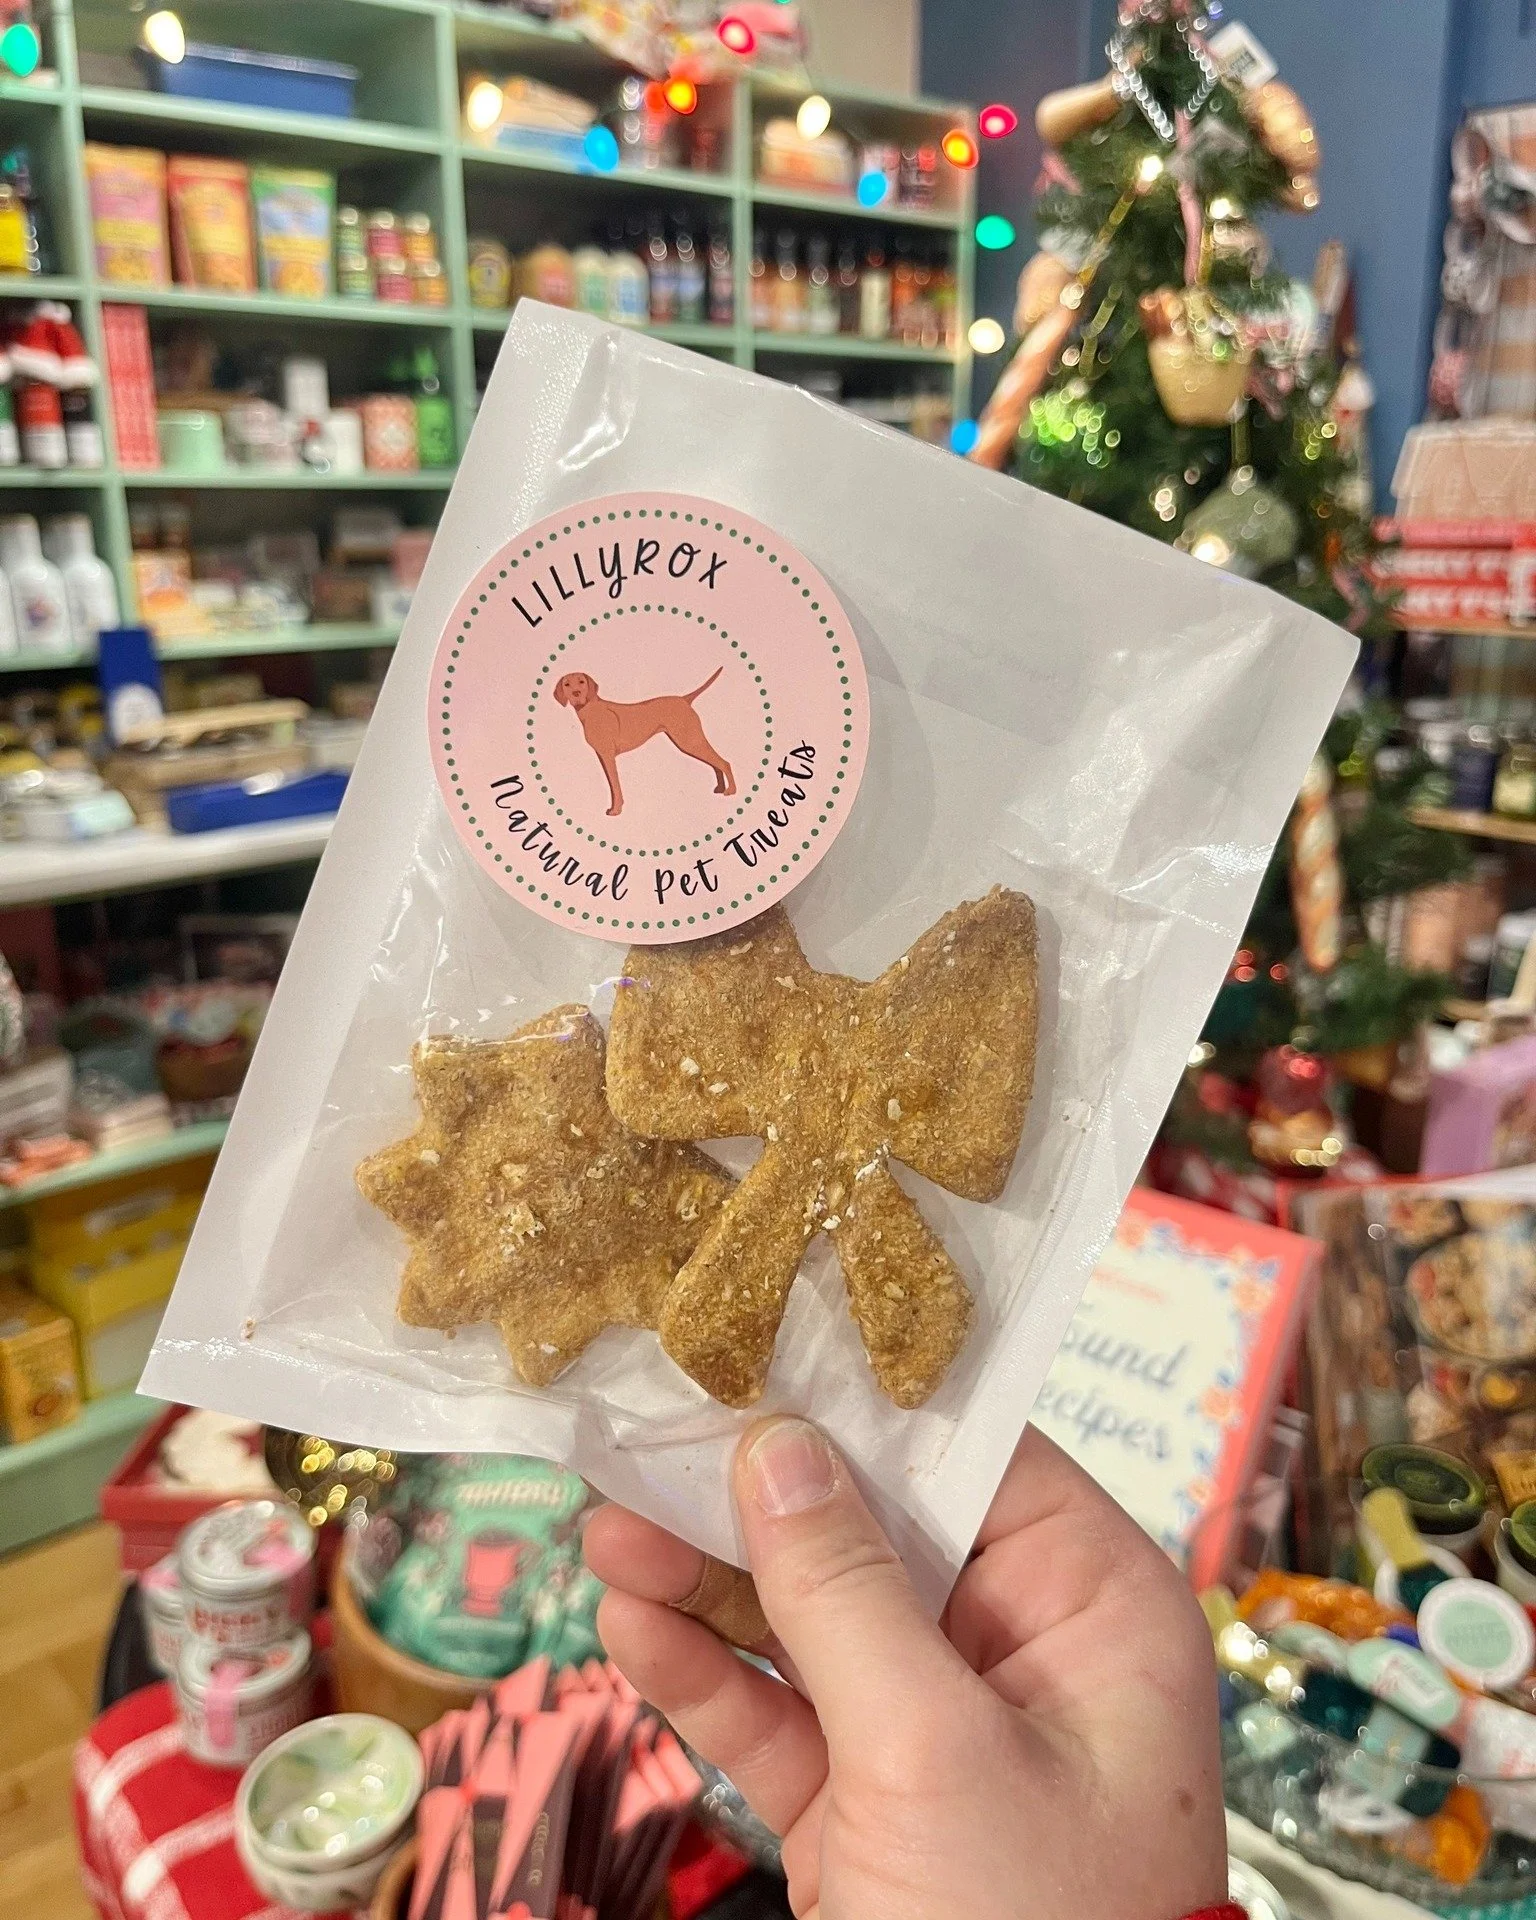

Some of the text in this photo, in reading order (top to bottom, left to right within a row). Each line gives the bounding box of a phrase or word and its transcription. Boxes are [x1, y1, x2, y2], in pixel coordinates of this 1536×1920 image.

[511, 538, 728, 628] LILLYROX
[490, 774, 629, 901] Natural
[722, 739, 816, 868] Treats
[1037, 1382, 1171, 1460] ecipes
